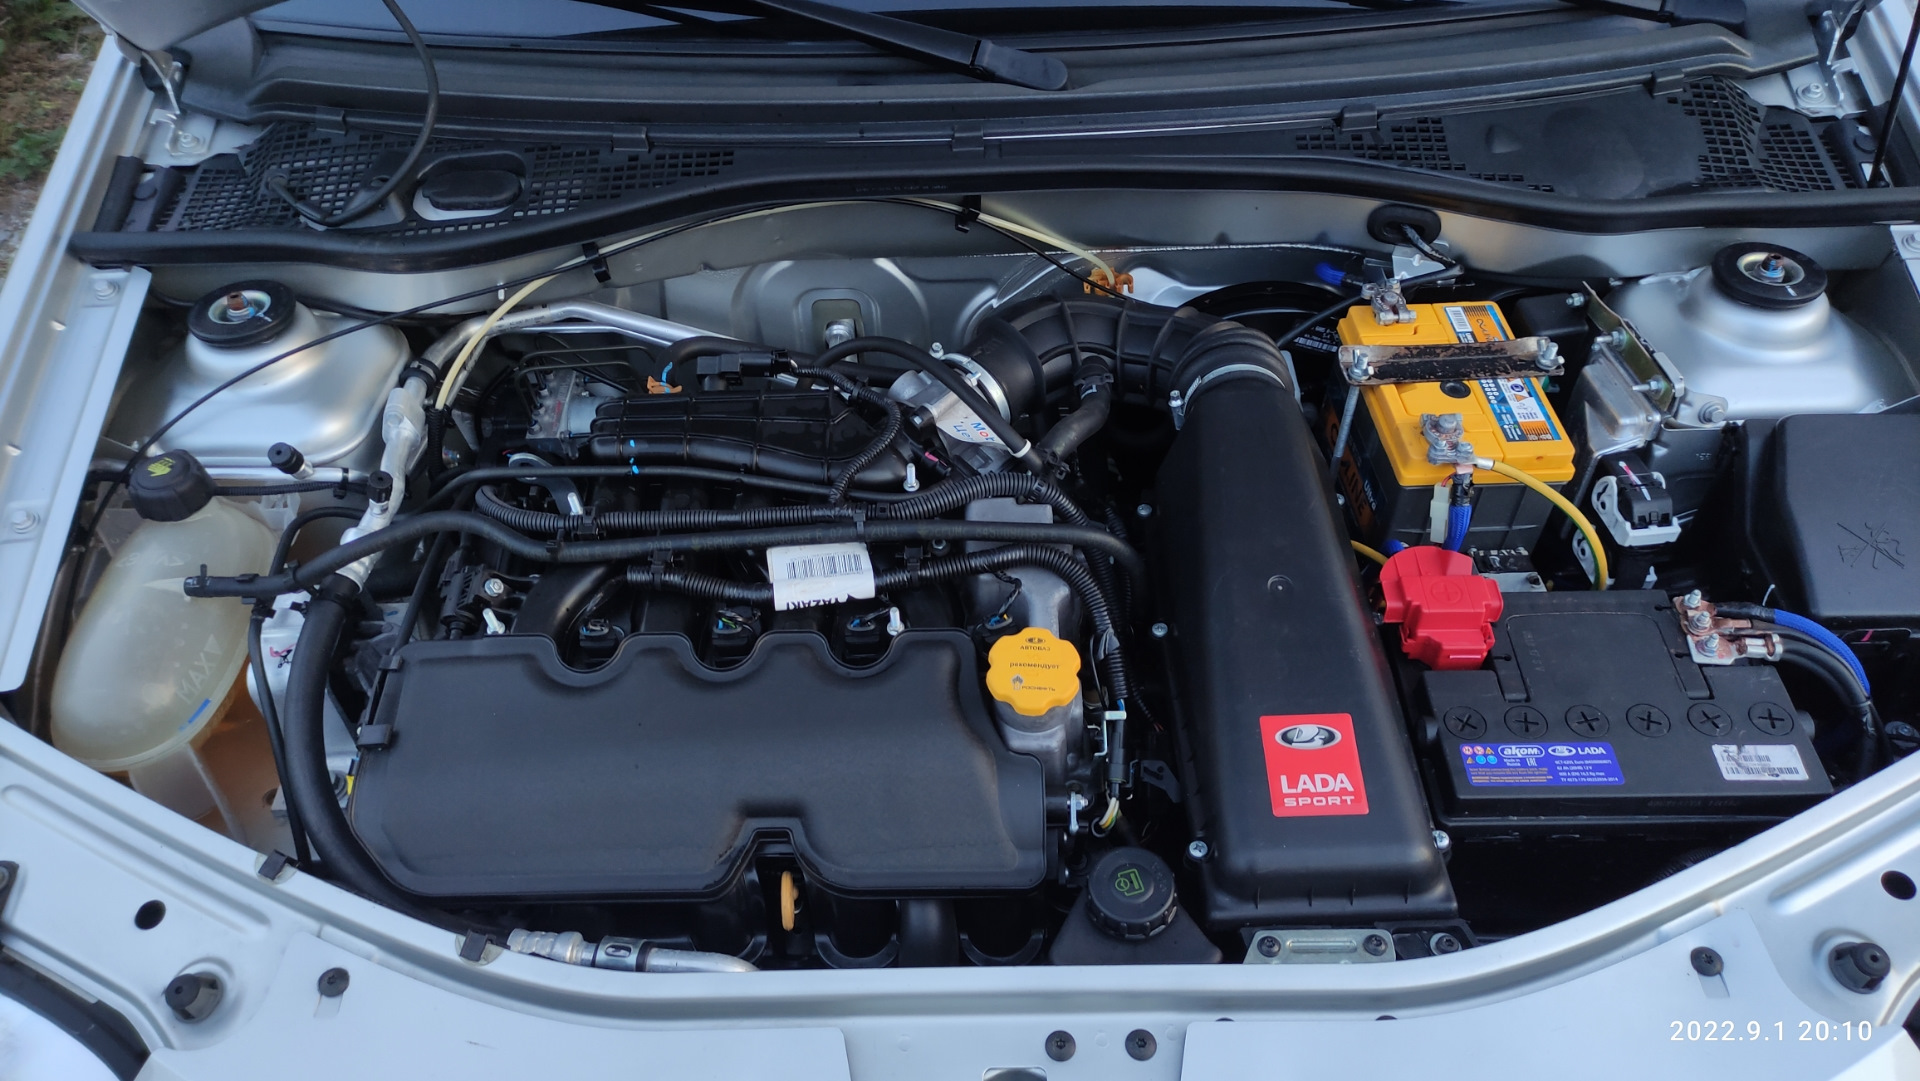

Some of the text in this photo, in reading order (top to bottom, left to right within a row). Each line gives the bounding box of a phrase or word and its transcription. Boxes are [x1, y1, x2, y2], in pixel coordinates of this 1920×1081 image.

[1363, 479, 1377, 512] Ultra
[1009, 662, 1060, 670] рекомендует
[176, 652, 217, 704] MAX
[1577, 747, 1607, 755] LADA
[1280, 773, 1355, 794] LADA
[1283, 796, 1355, 807] SPORT
